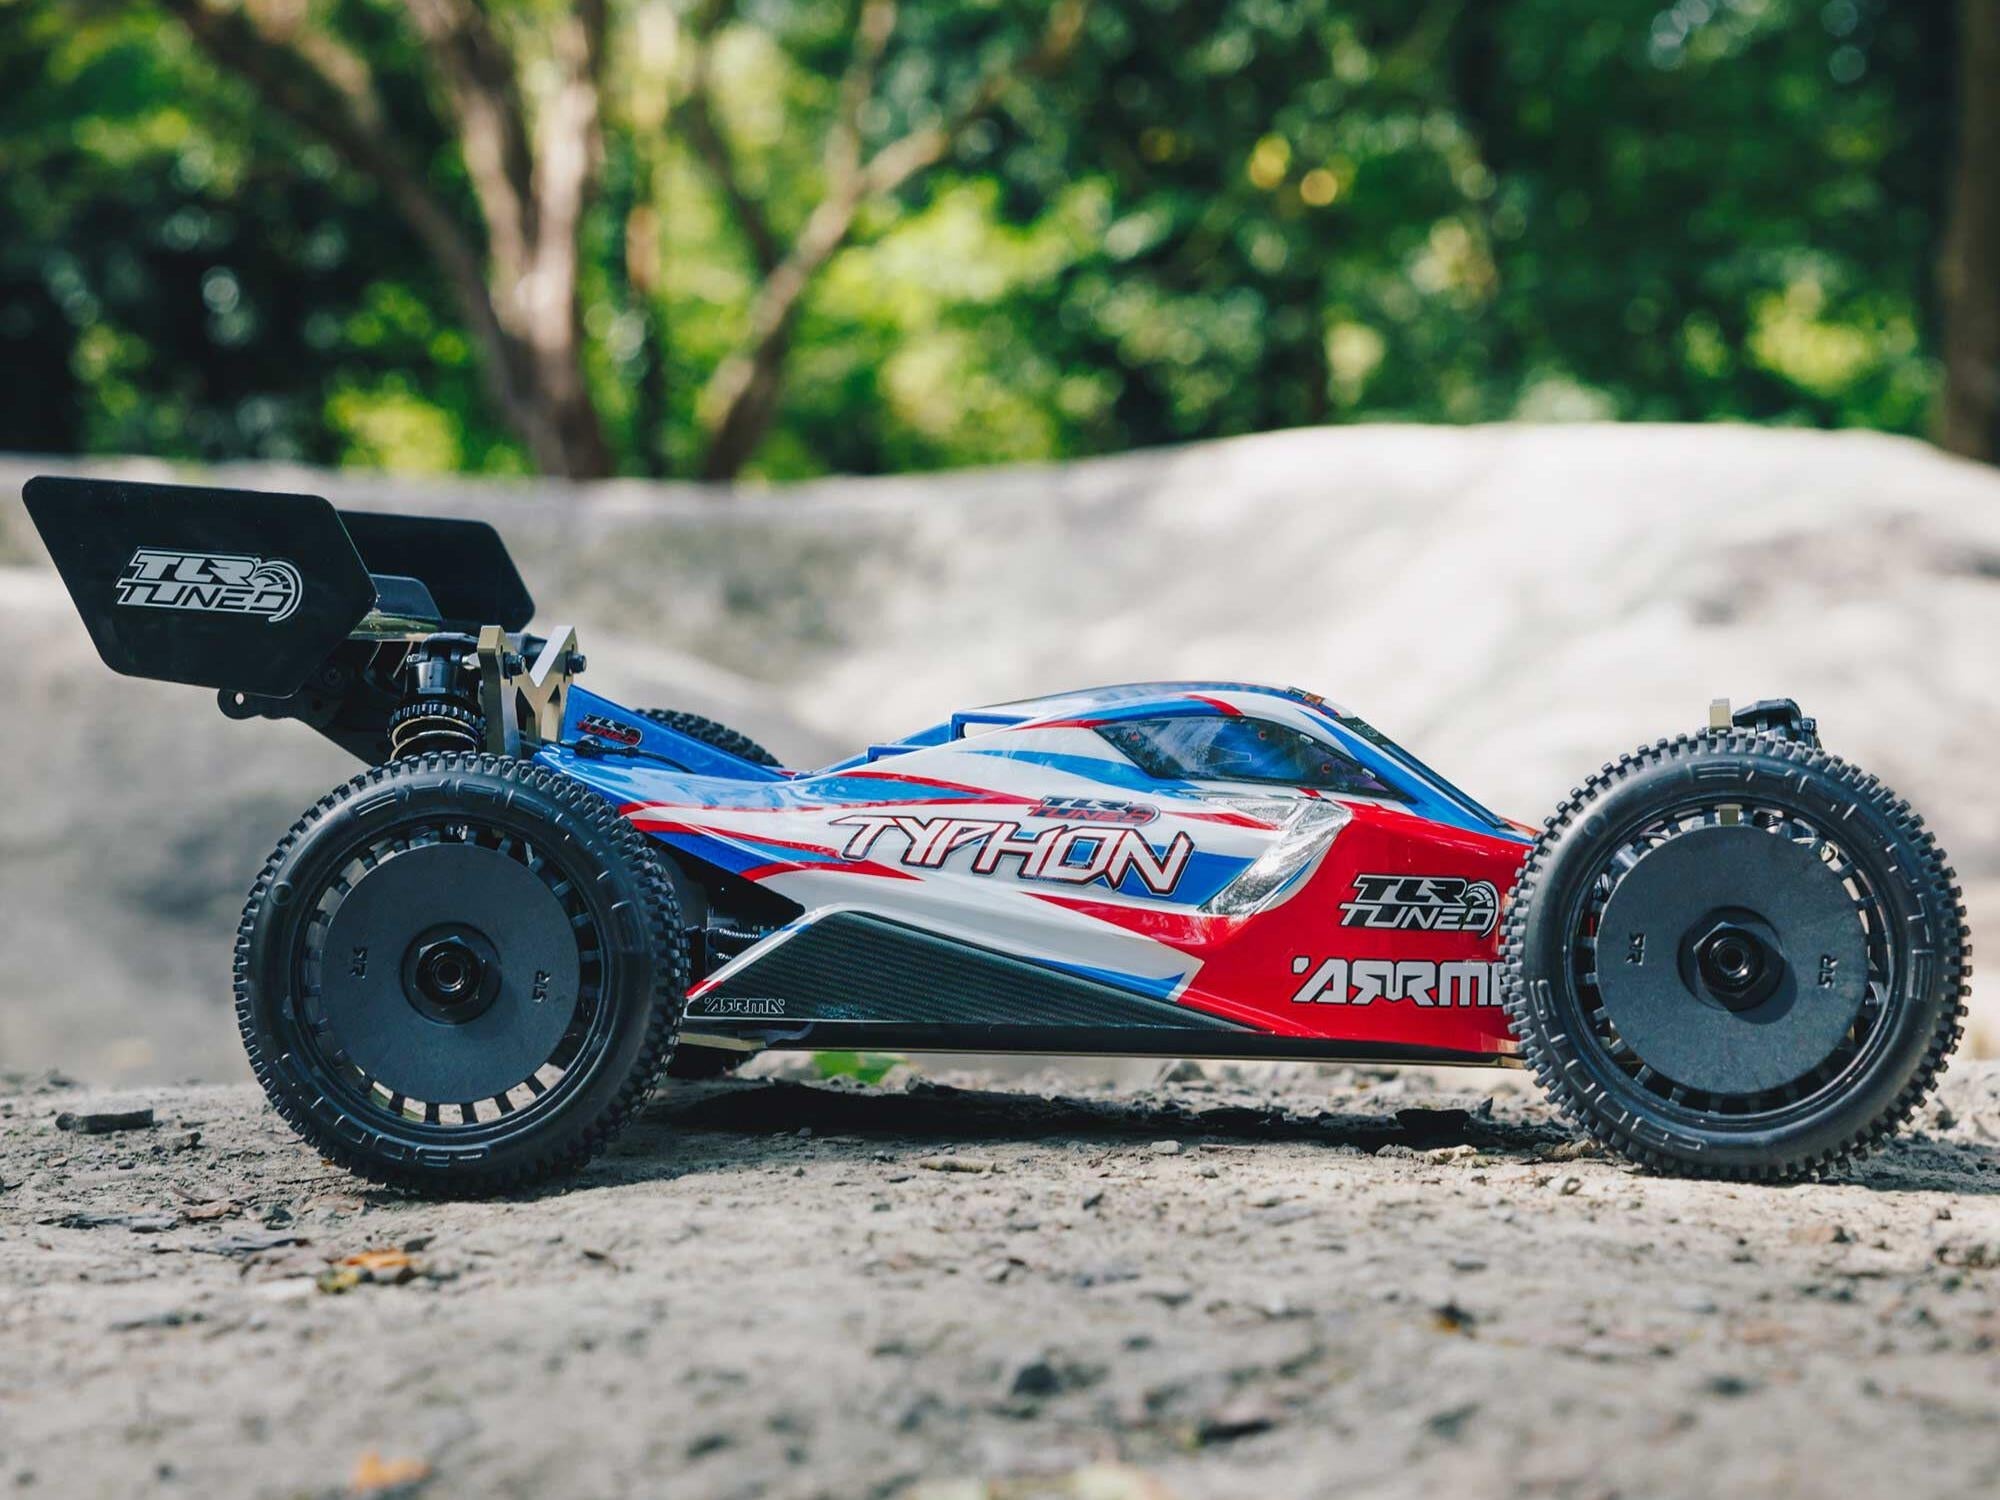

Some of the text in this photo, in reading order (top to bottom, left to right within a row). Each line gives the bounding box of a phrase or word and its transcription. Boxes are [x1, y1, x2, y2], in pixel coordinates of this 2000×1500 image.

[132, 551, 258, 587] TLR
[115, 578, 293, 614] TUNED
[1042, 795, 1131, 813] TLR
[829, 814, 1195, 895] TYPHON
[1353, 874, 1468, 906] TLR
[1338, 903, 1496, 931] TUNED
